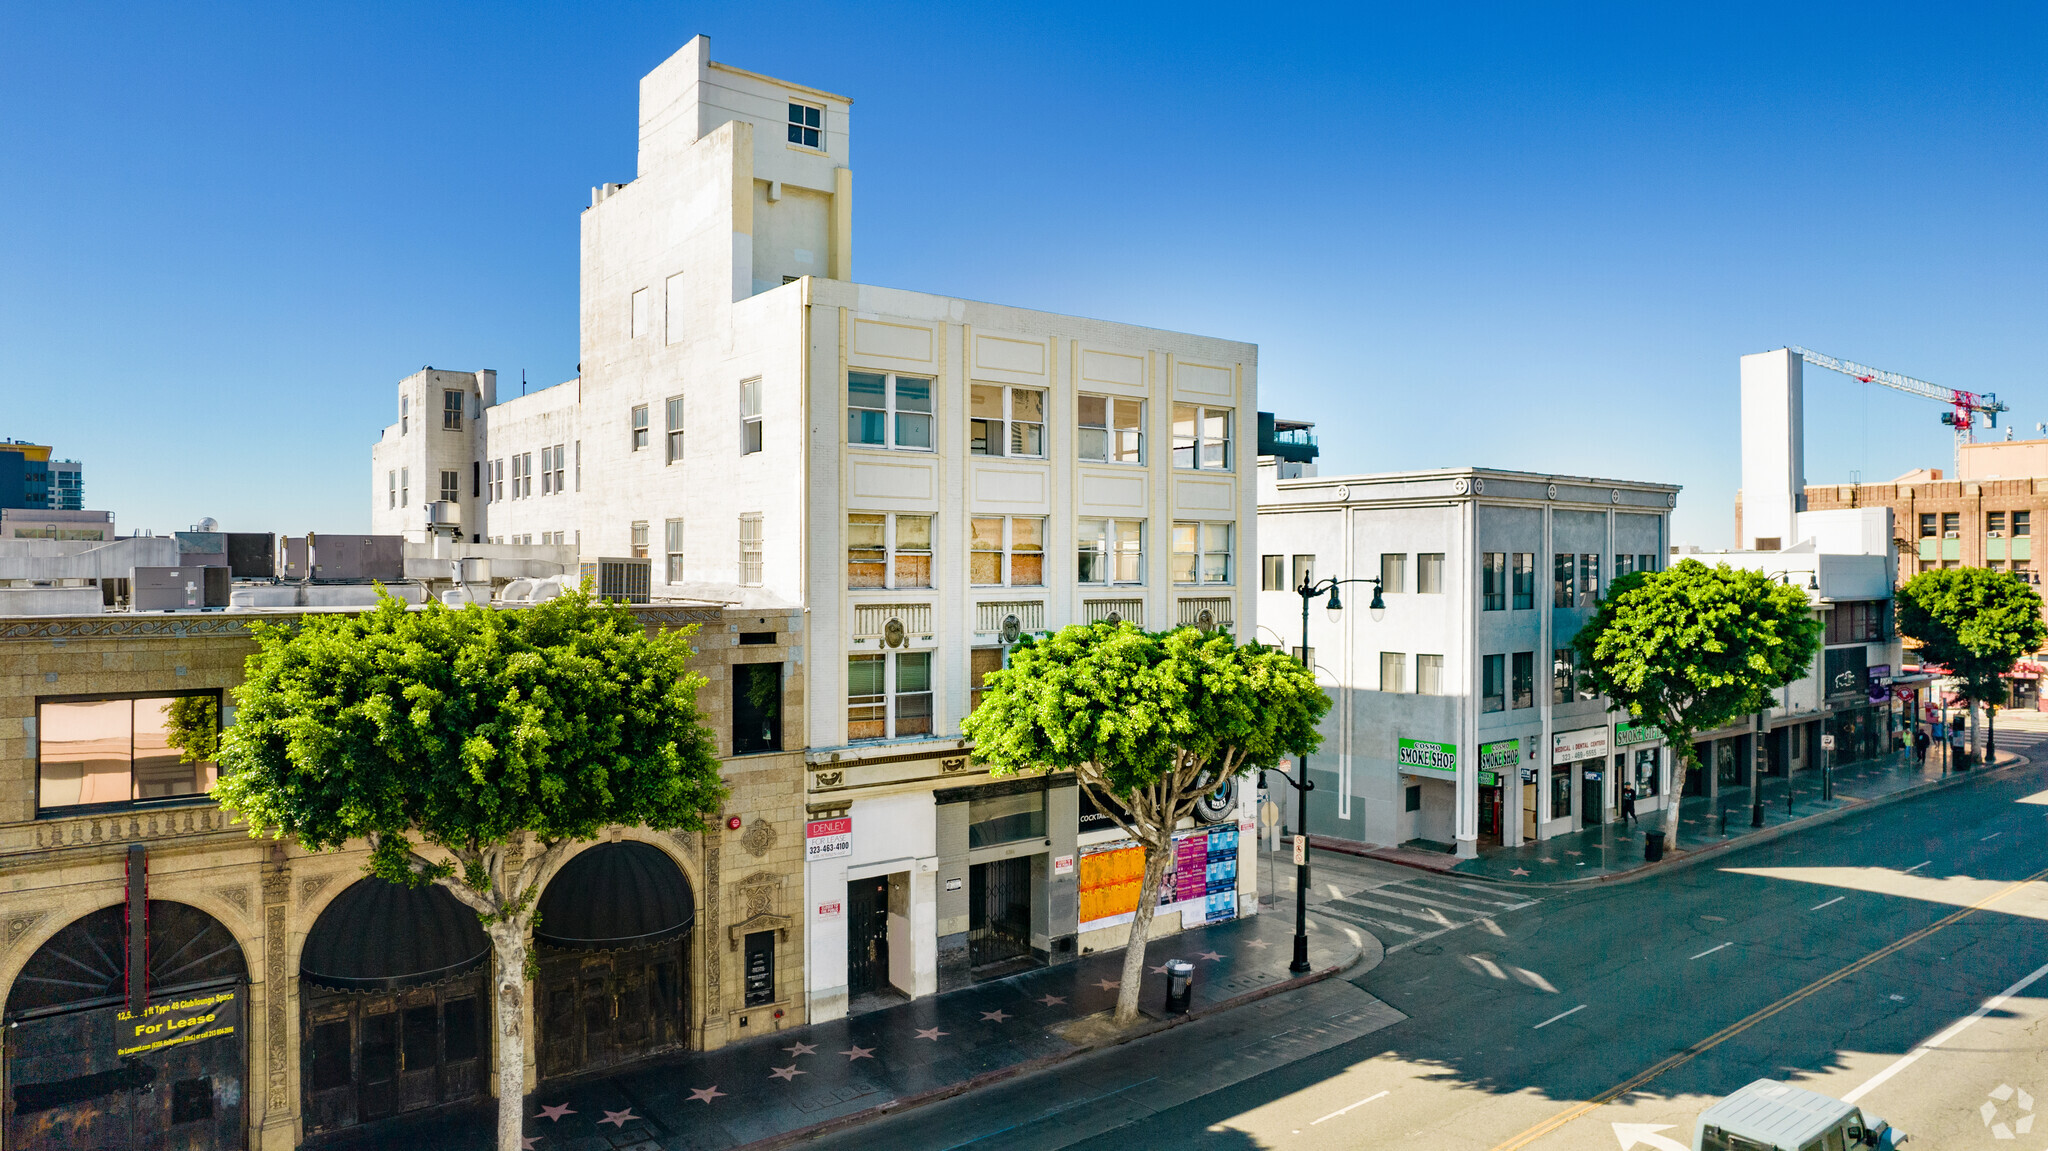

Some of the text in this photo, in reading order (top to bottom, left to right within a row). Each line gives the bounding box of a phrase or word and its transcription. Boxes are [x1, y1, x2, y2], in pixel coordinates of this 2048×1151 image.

[1618, 728, 1643, 744] SMOKE
[1414, 742, 1441, 751] COSMO
[1492, 743, 1509, 751] COSMO
[1555, 745, 1571, 753] MEDICAL
[1575, 742, 1589, 750] DENTAL
[1400, 748, 1455, 769] SMOKE SHOP
[1482, 749, 1519, 769] SMOKE SHOP
[813, 821, 845, 833] DENLEY
[812, 834, 847, 846] FOR LEASE
[155, 1005, 171, 1015] Type
[215, 993, 234, 1003] Space
[135, 1013, 216, 1036] For Lease
